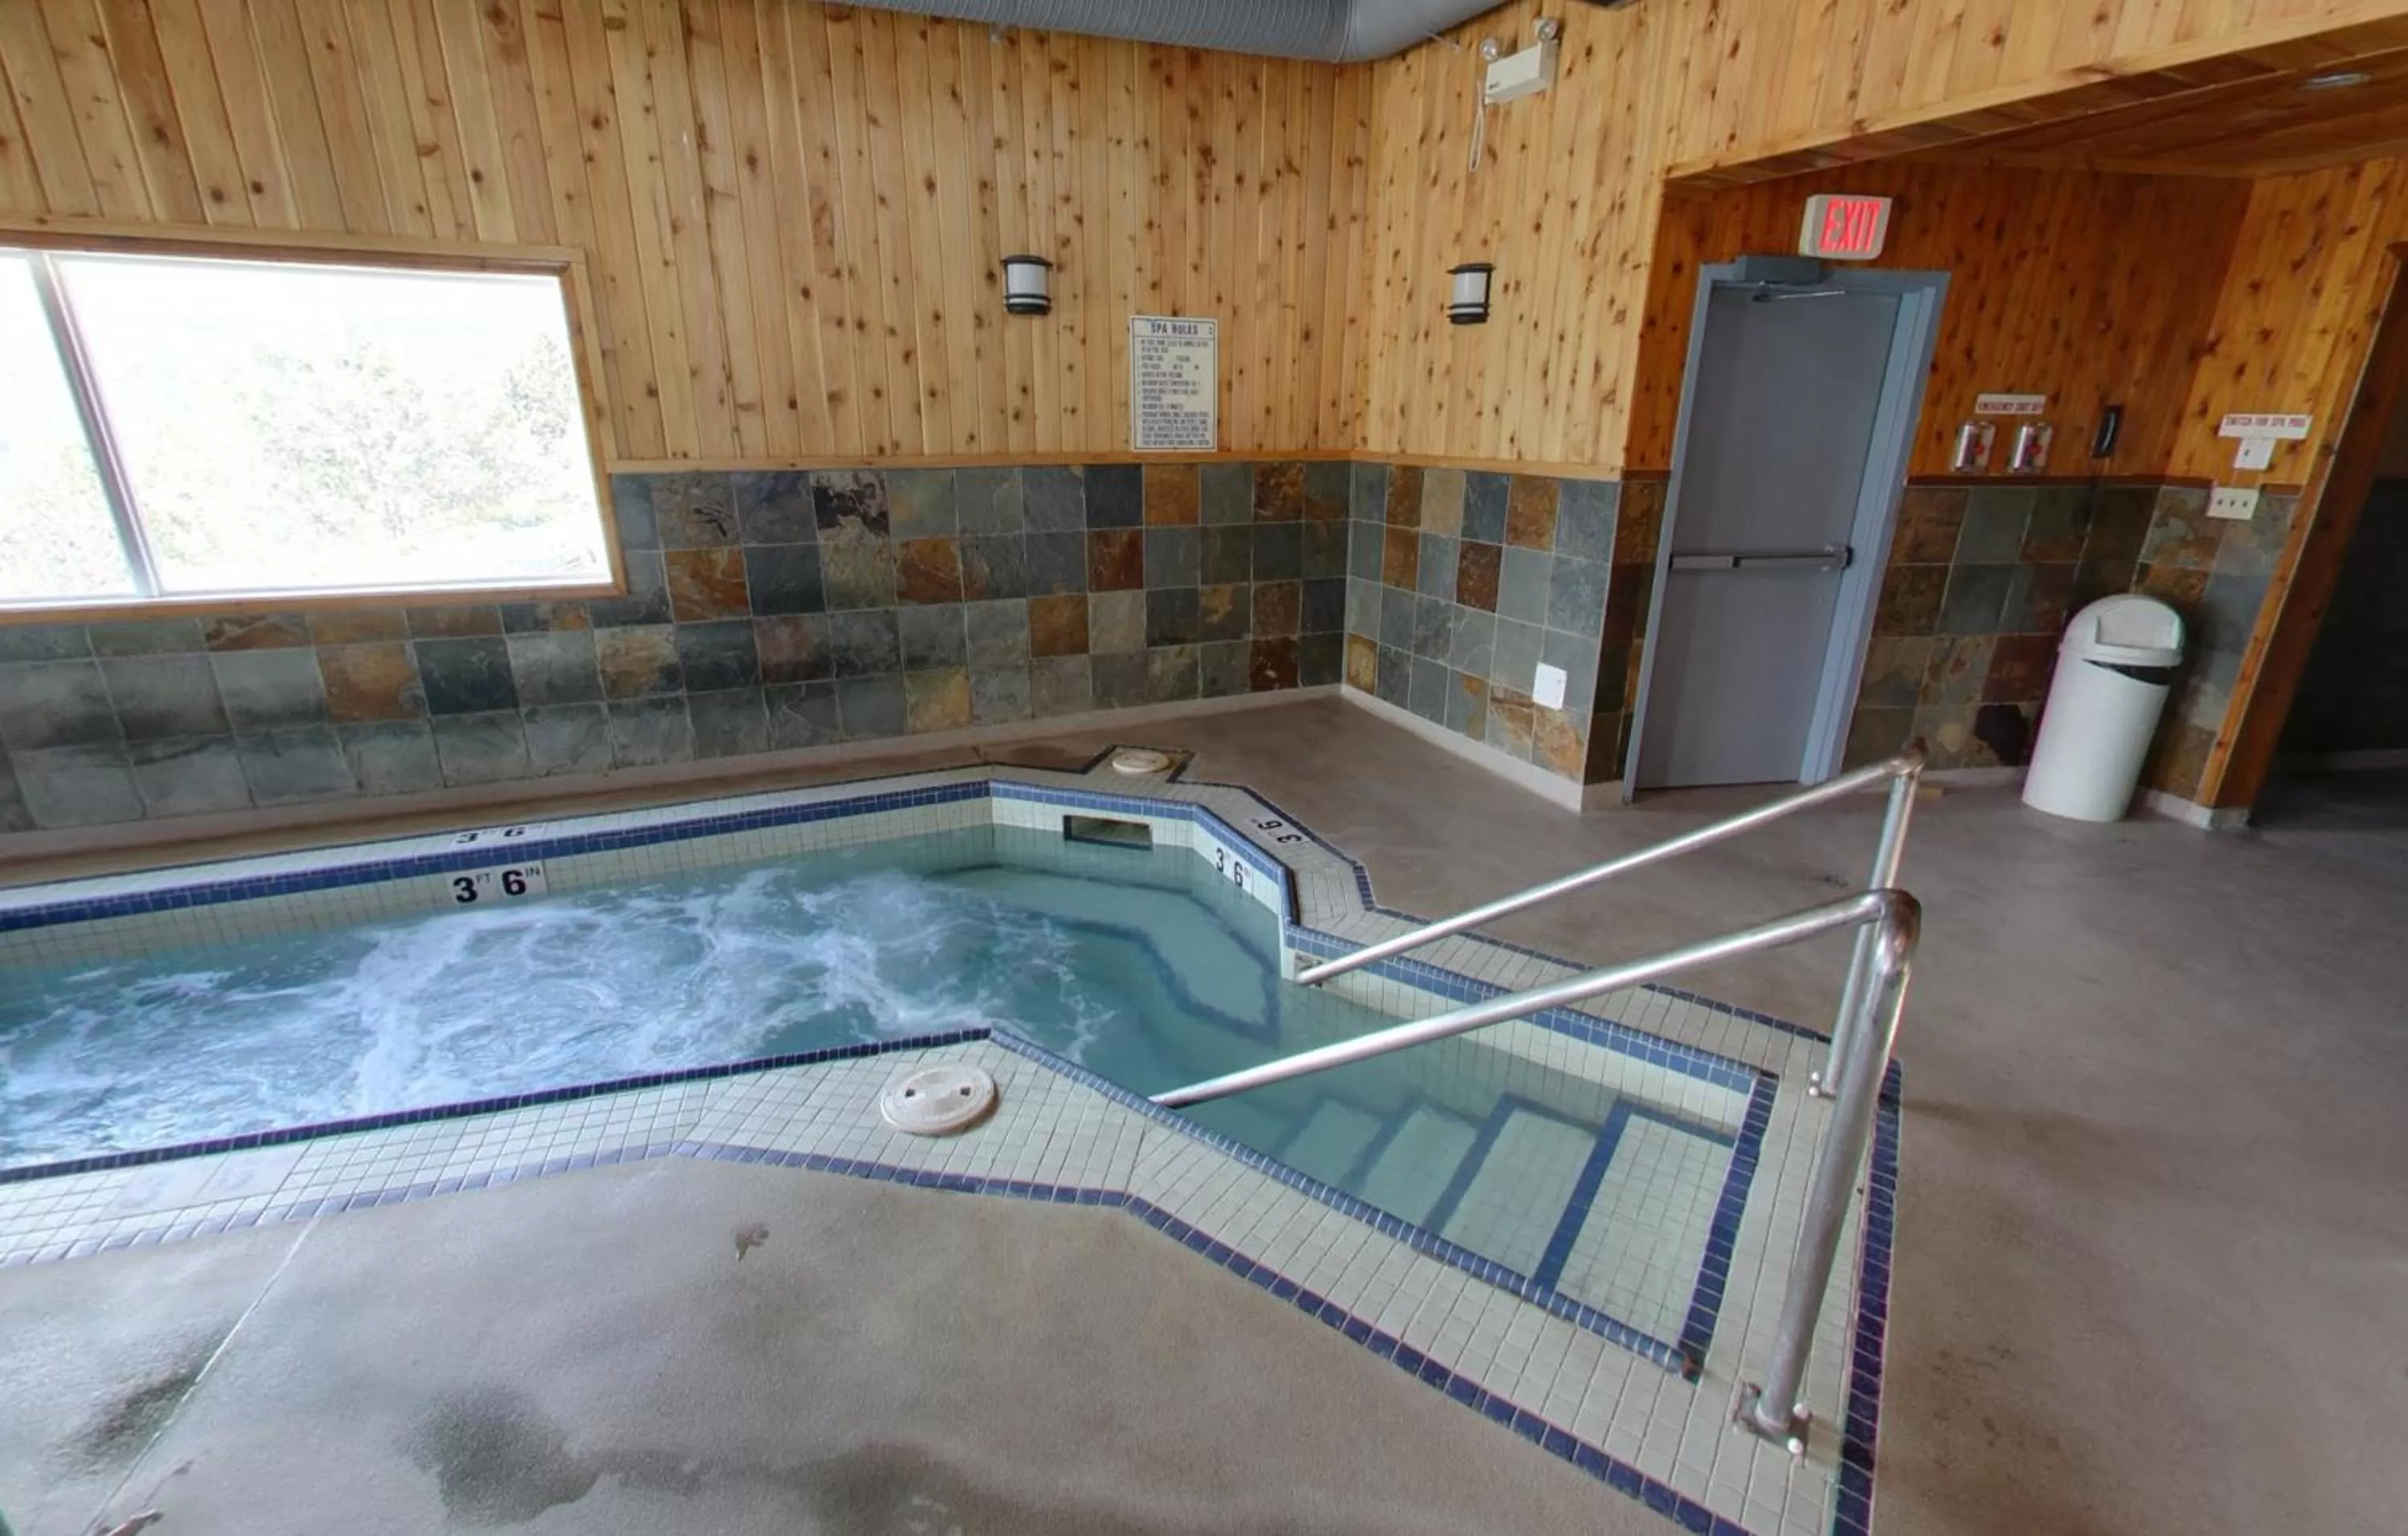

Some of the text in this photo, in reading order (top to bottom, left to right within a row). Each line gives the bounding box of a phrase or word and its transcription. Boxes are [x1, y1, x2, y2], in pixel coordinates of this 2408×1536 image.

[1820, 198, 1882, 252] EXIT
[1151, 323, 1168, 334] SPA
[1172, 323, 1198, 335] RULES
[456, 832, 478, 843] 3
[503, 827, 527, 837] 6
[1215, 847, 1224, 872] 3
[1234, 861, 1243, 887] 6
[453, 876, 478, 903] 3
[502, 869, 527, 896] 6
